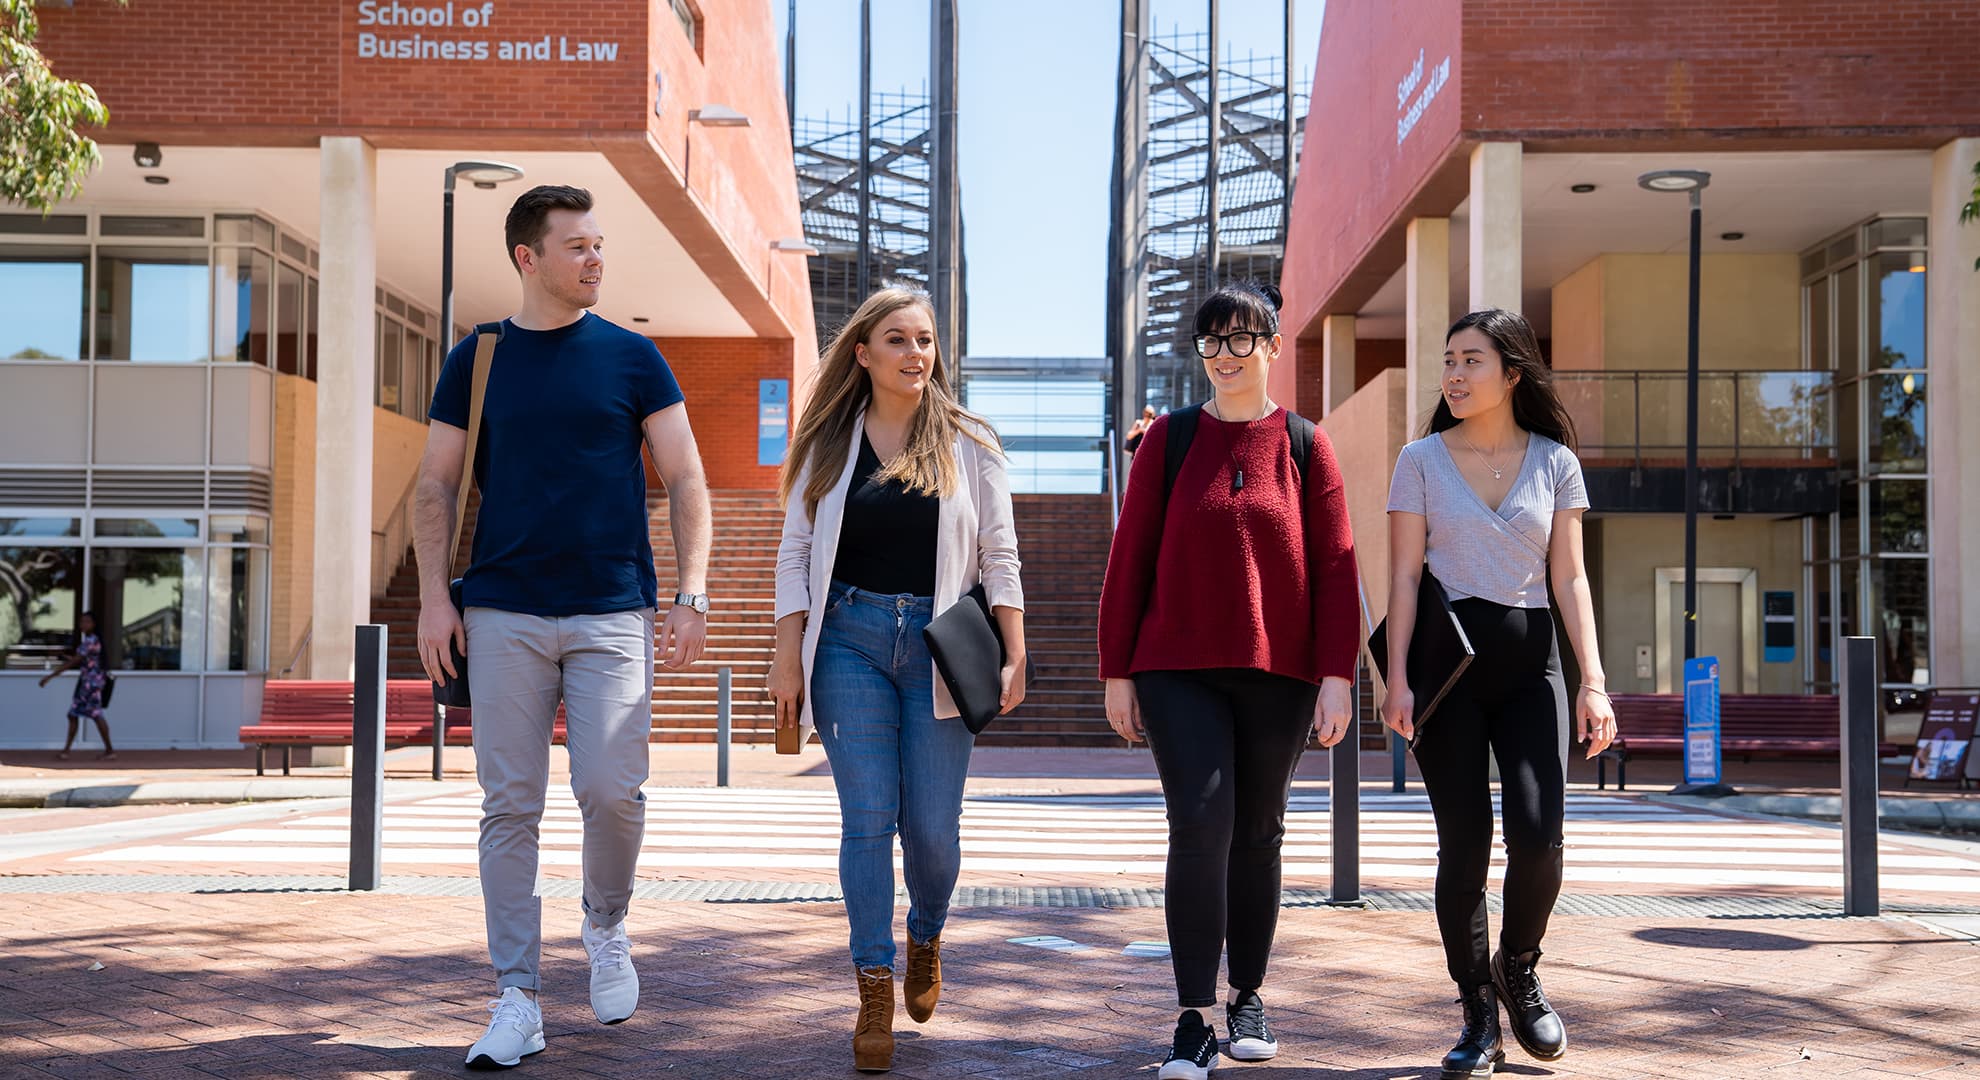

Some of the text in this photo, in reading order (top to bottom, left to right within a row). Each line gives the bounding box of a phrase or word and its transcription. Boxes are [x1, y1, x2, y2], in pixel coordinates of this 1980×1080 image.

[358, 0, 494, 27] School of
[358, 32, 618, 62] Business and Law
[769, 383, 778, 396] 2
